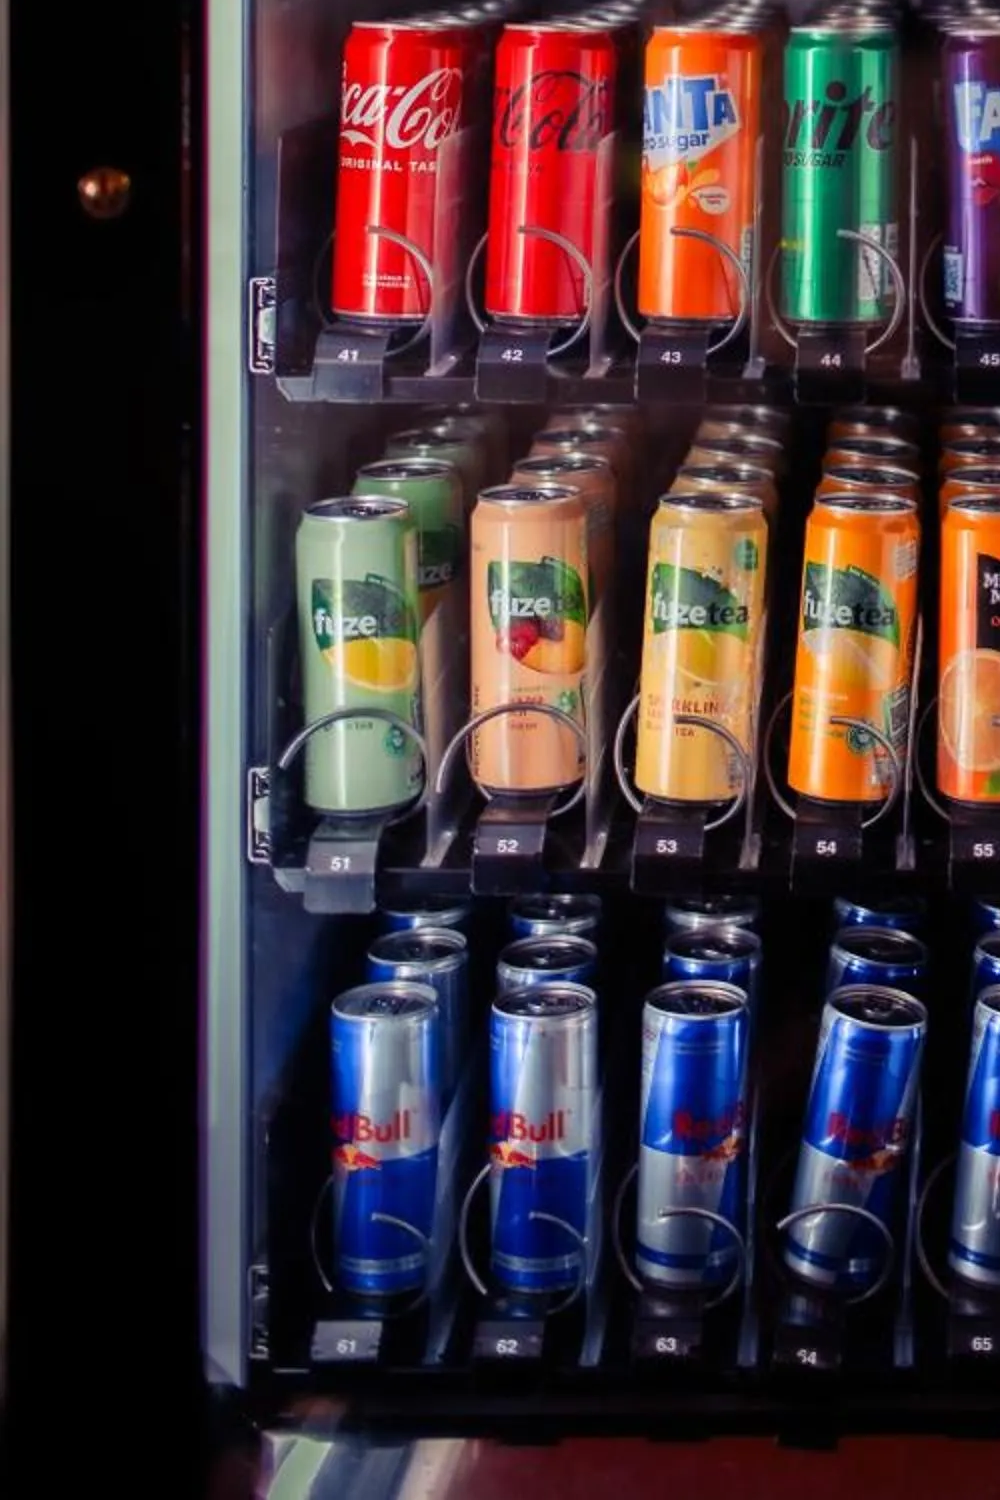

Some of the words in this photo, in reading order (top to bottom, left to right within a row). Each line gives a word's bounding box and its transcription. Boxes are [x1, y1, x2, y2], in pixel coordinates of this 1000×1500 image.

[643, 77, 737, 134] NTA
[782, 82, 895, 151] rite
[656, 132, 711, 151] sgar
[409, 160, 438, 173] TAS
[338, 349, 359, 363] 41
[501, 349, 523, 362] 42
[660, 351, 681, 364] 43
[820, 353, 841, 367] 44
[979, 353, 1000, 366] 45
[491, 589, 550, 617] fuze
[653, 592, 707, 625] fuze
[709, 603, 750, 625] tea
[314, 607, 378, 636] fuze
[852, 603, 895, 626] tea
[496, 839, 519, 854] 52
[656, 839, 678, 854] 53
[816, 840, 837, 855] 54
[973, 843, 994, 857] 55
[328, 856, 350, 871] 51
[353, 1109, 411, 1142] Bull
[510, 1109, 565, 1142] Bull
[336, 1339, 357, 1354] 61
[495, 1339, 518, 1354] 62
[655, 1337, 677, 1352] 63
[972, 1337, 993, 1351] 65
